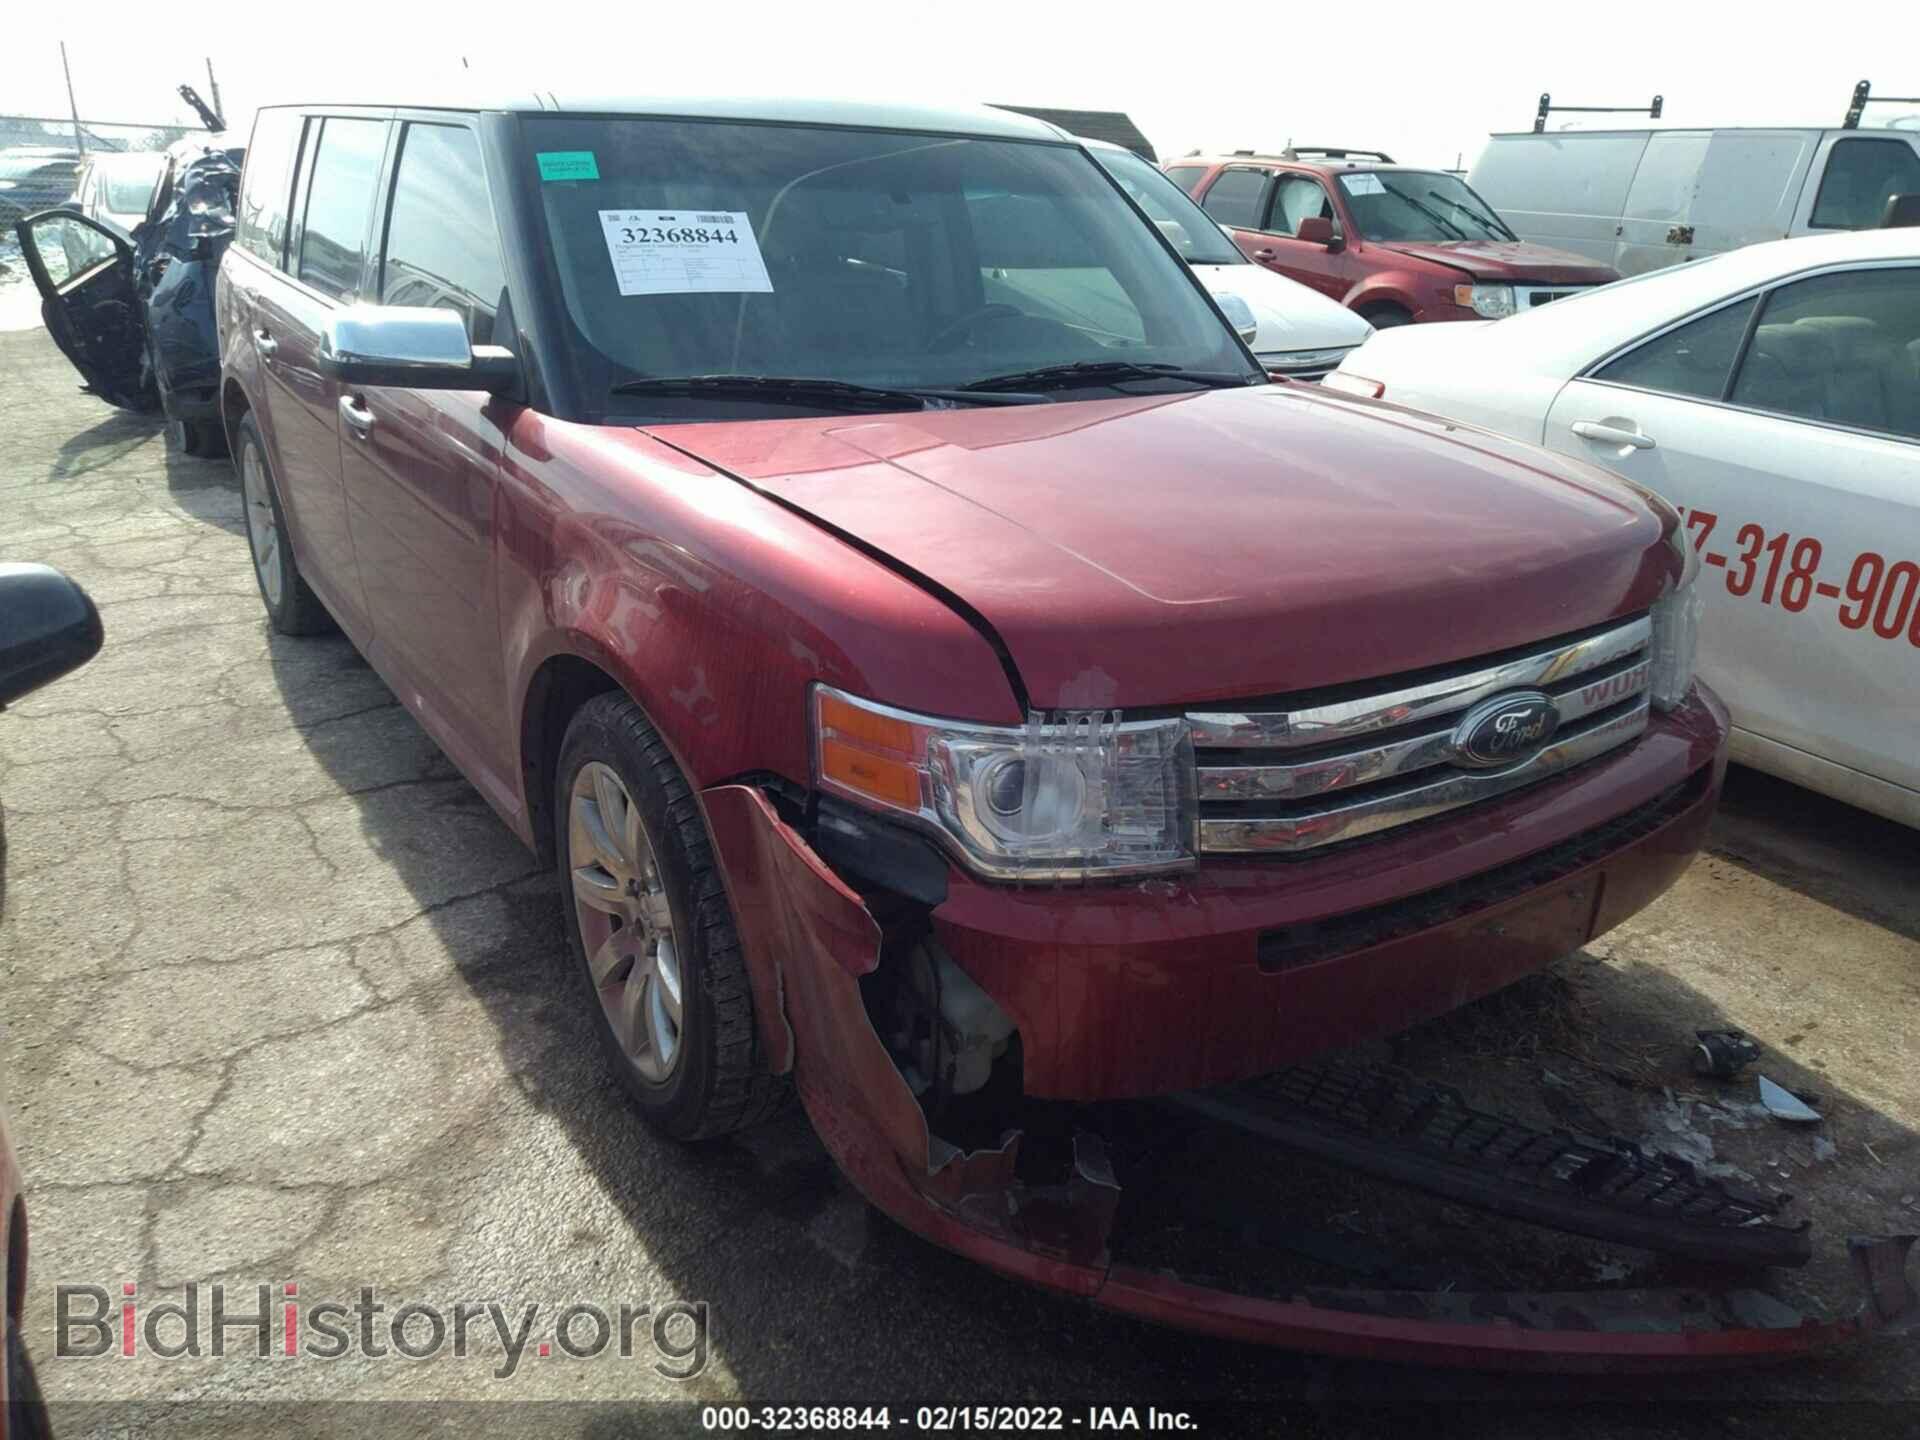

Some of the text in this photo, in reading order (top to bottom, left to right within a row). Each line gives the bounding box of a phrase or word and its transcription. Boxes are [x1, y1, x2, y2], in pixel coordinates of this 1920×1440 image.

[620, 227, 739, 245] 32368844
[1677, 506, 1920, 649] 7-318-90
[1490, 708, 1547, 751] Ford
